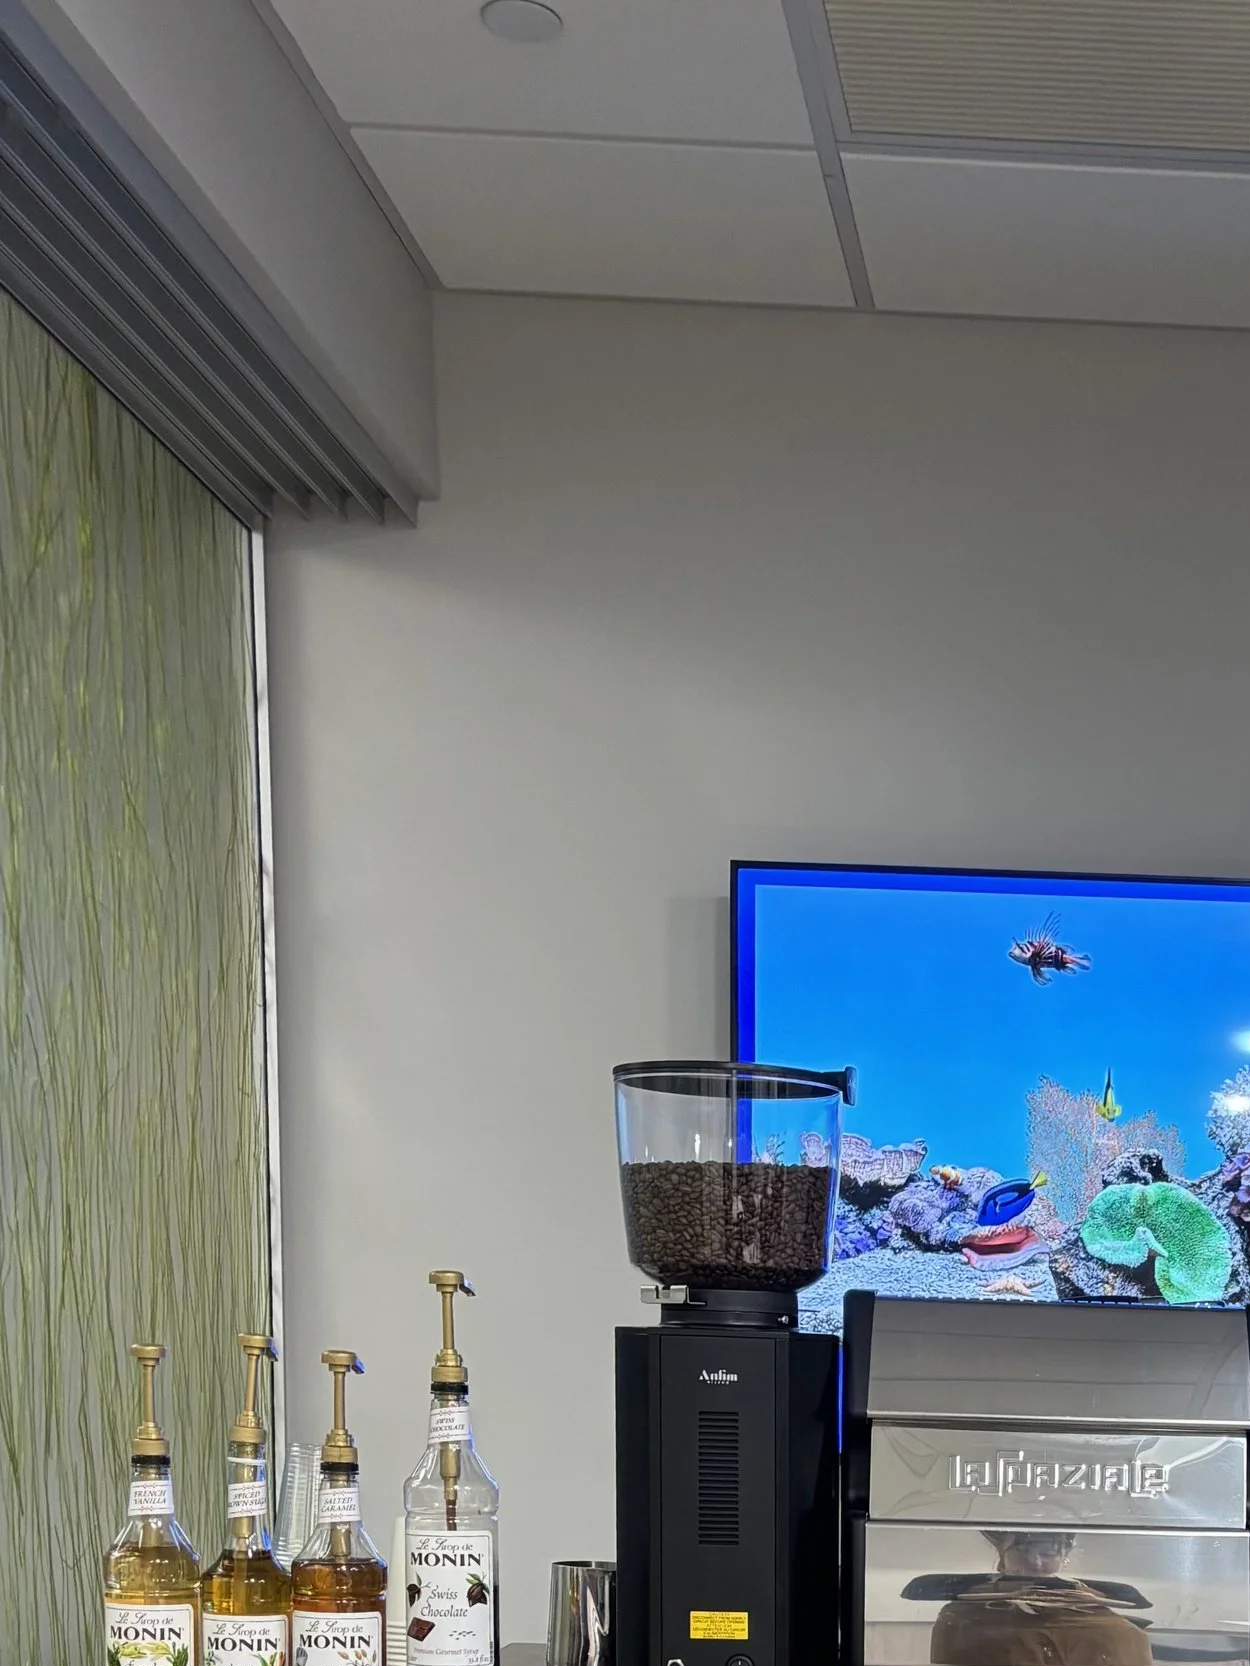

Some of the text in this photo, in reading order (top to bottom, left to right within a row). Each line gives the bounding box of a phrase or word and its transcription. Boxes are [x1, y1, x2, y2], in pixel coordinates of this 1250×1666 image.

[699, 1369, 738, 1381] Anfim
[134, 1490, 167, 1498] FRENCH
[134, 1497, 167, 1505] VANILLA
[233, 1491, 260, 1500] SPICED
[324, 1497, 353, 1505] SALTED
[321, 1504, 356, 1512] CARAMEL
[416, 1537, 473, 1554] Le Sirop de
[410, 1552, 481, 1567] MONIN
[429, 1585, 458, 1600] Swiss
[420, 1604, 468, 1618] Chocolate
[116, 1611, 174, 1629] Le Sirop de
[110, 1625, 182, 1640] MONIN
[213, 1622, 270, 1639] Le Sirop de
[305, 1620, 363, 1636] Le Sirop de
[207, 1636, 278, 1652] MONIN
[299, 1634, 371, 1649] MONIN
